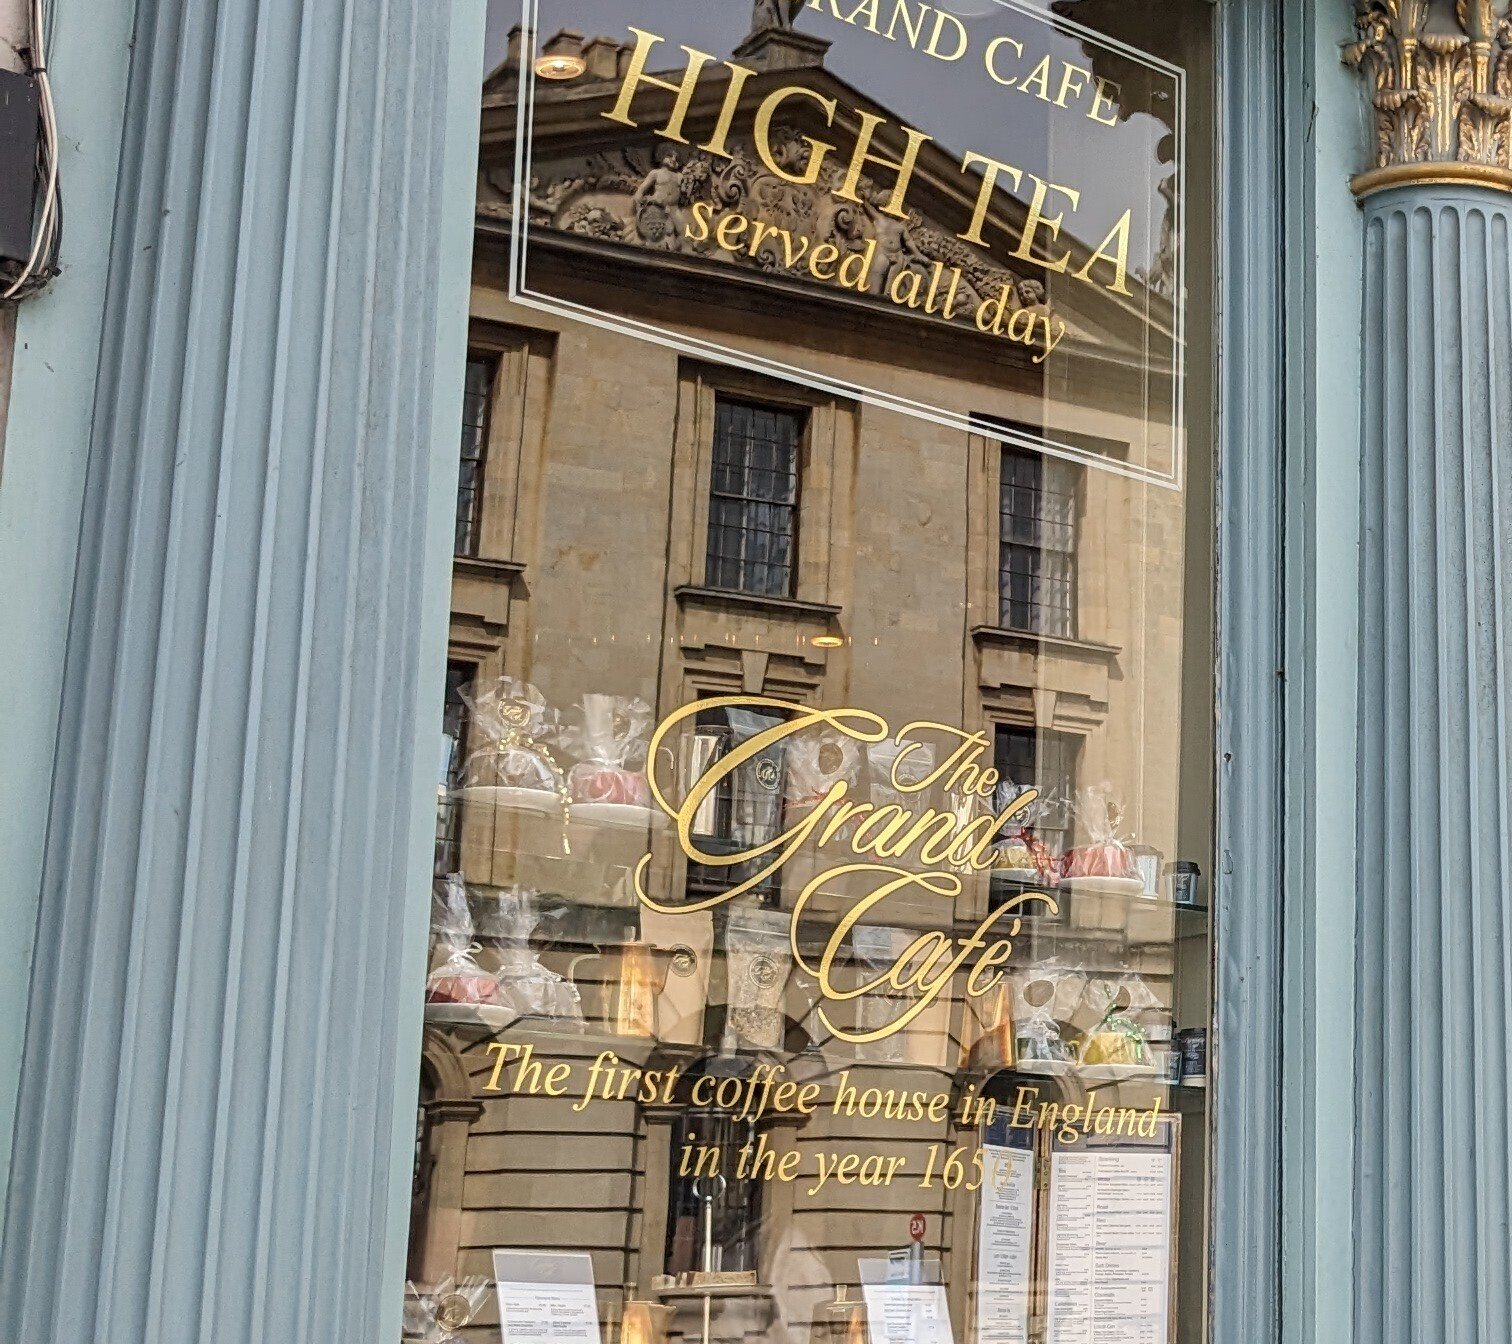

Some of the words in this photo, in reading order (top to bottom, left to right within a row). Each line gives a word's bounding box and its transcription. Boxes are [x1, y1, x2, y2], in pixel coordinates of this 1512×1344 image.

[984, 36, 1122, 127] CAFE
[600, 27, 934, 221] HIGH
[956, 149, 1134, 298] TEA
[685, 201, 878, 293] served
[891, 261, 959, 320] all
[977, 288, 1068, 364] day
[635, 696, 1040, 914] Grand
[890, 720, 999, 798] The
[790, 864, 1059, 1043] Café
[482, 1042, 571, 1096] The
[573, 1051, 681, 1112] first
[691, 1064, 820, 1123] coffee
[834, 1072, 949, 1123] house
[961, 1084, 997, 1125] in
[1010, 1086, 1163, 1144] England
[678, 1133, 721, 1177] in
[735, 1134, 801, 1182] the
[807, 1151, 906, 1196] year
